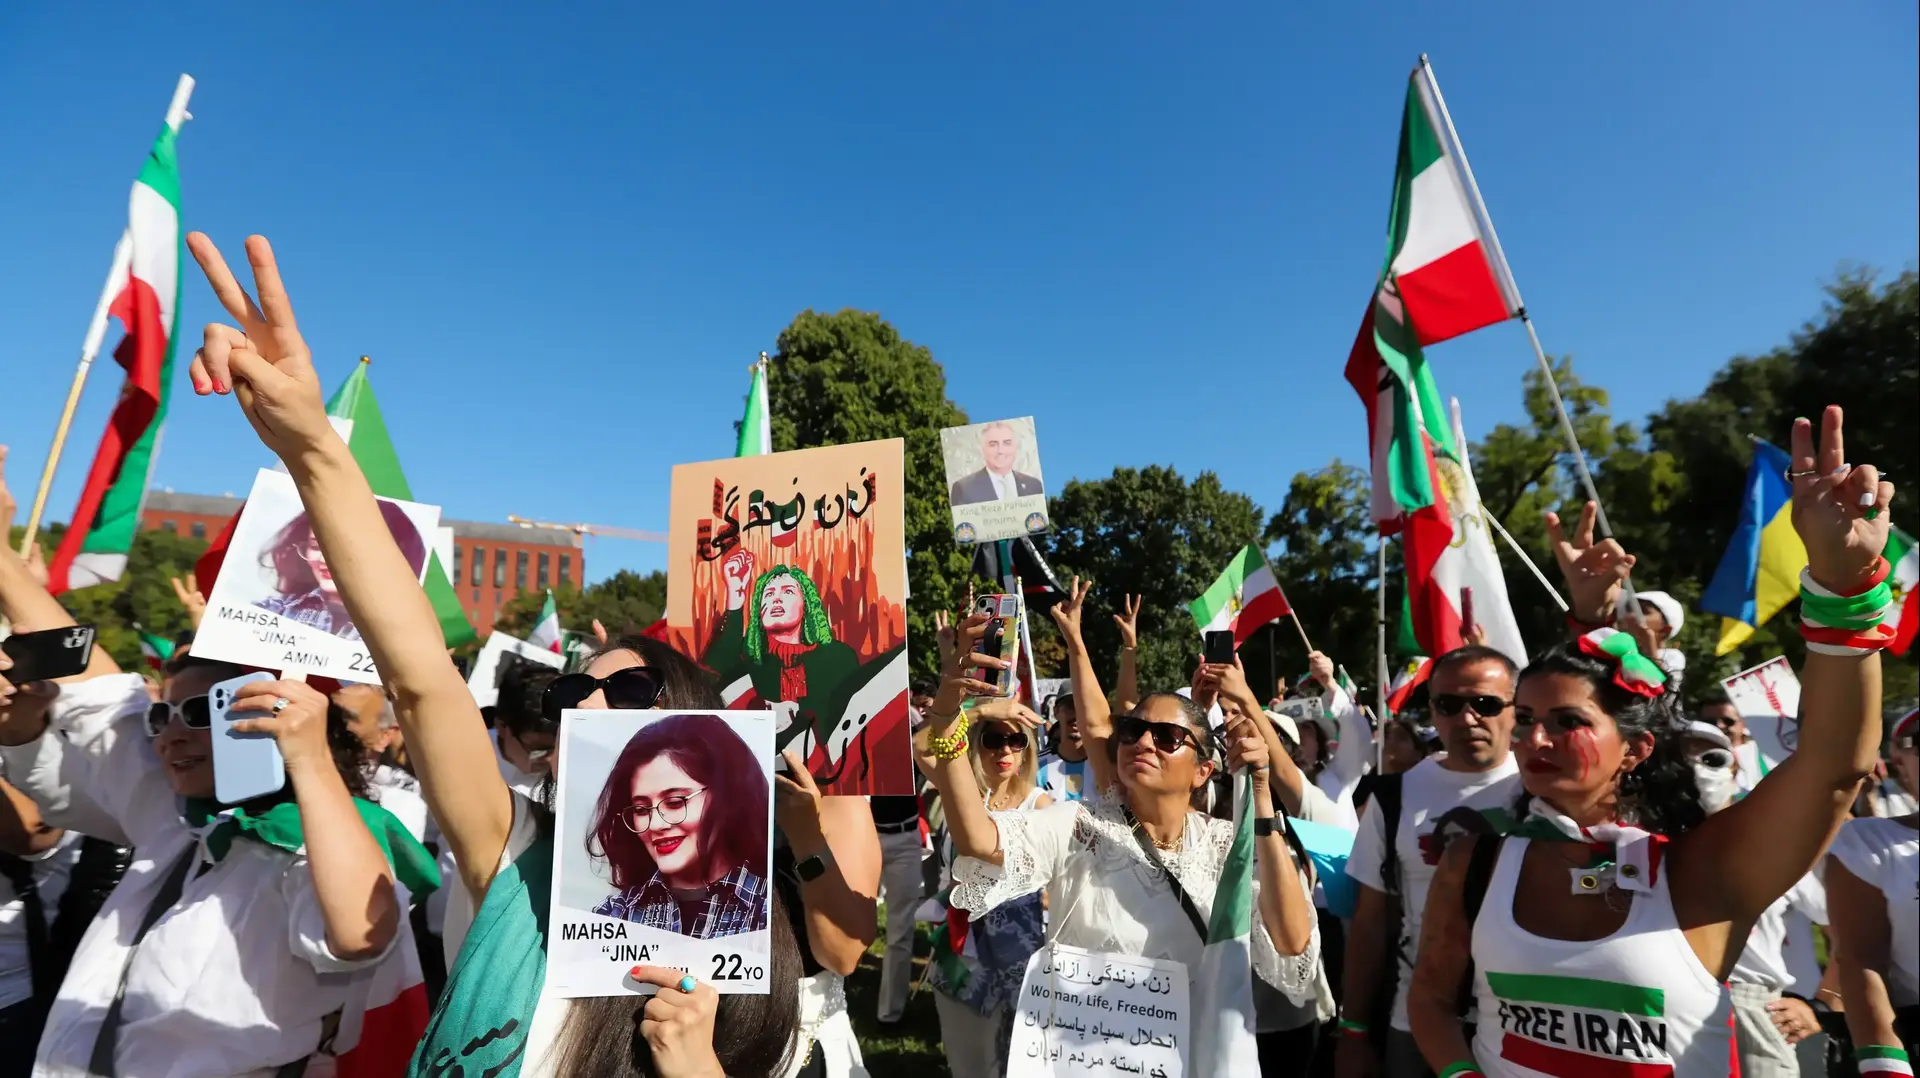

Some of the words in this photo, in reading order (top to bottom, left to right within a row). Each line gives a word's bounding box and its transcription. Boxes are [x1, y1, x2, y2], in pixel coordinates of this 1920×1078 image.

[218, 606, 280, 628] MAHSA
[282, 650, 330, 668] AMINI
[562, 922, 628, 940] MAHSA
[601, 944, 660, 962] “JINA”
[1086, 994, 1113, 1011] Life,
[1117, 1000, 1178, 1021] Freedom
[1091, 1021, 1125, 1044] سپاه
[1129, 1027, 1177, 1050] انحلال
[1498, 1001, 1566, 1044] FREE
[1573, 1012, 1667, 1058] IRAN
[1068, 1050, 1104, 1069] مردم
